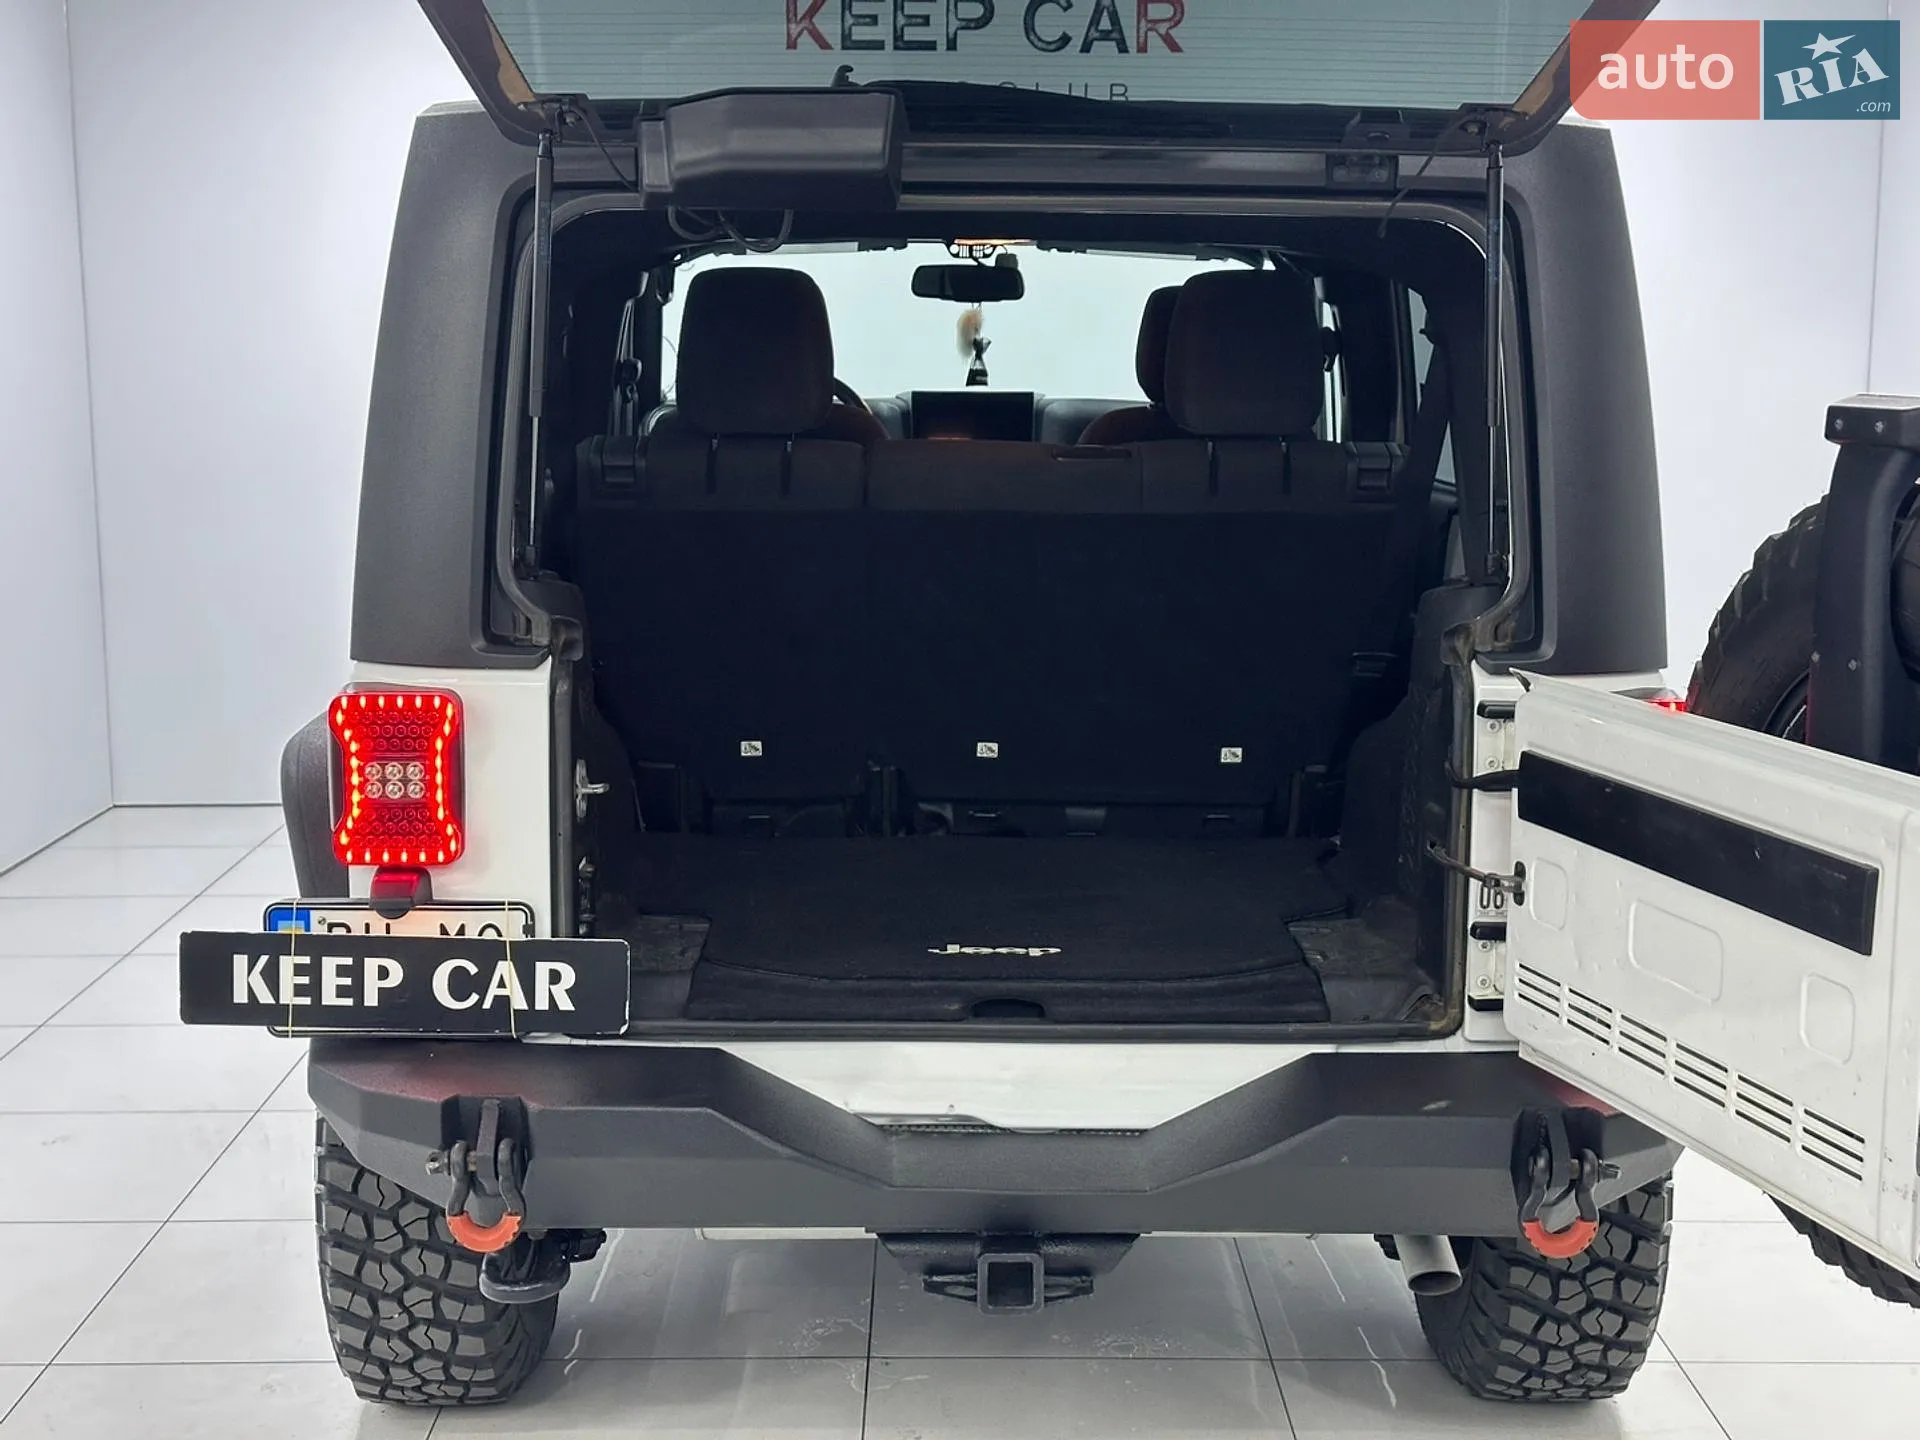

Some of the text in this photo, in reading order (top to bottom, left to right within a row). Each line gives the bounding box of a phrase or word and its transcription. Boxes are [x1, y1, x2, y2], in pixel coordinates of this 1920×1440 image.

[786, 0, 1184, 53] KEEP CAR
[927, 943, 1062, 957] Jeep
[232, 953, 577, 1011] KEEP CAR
